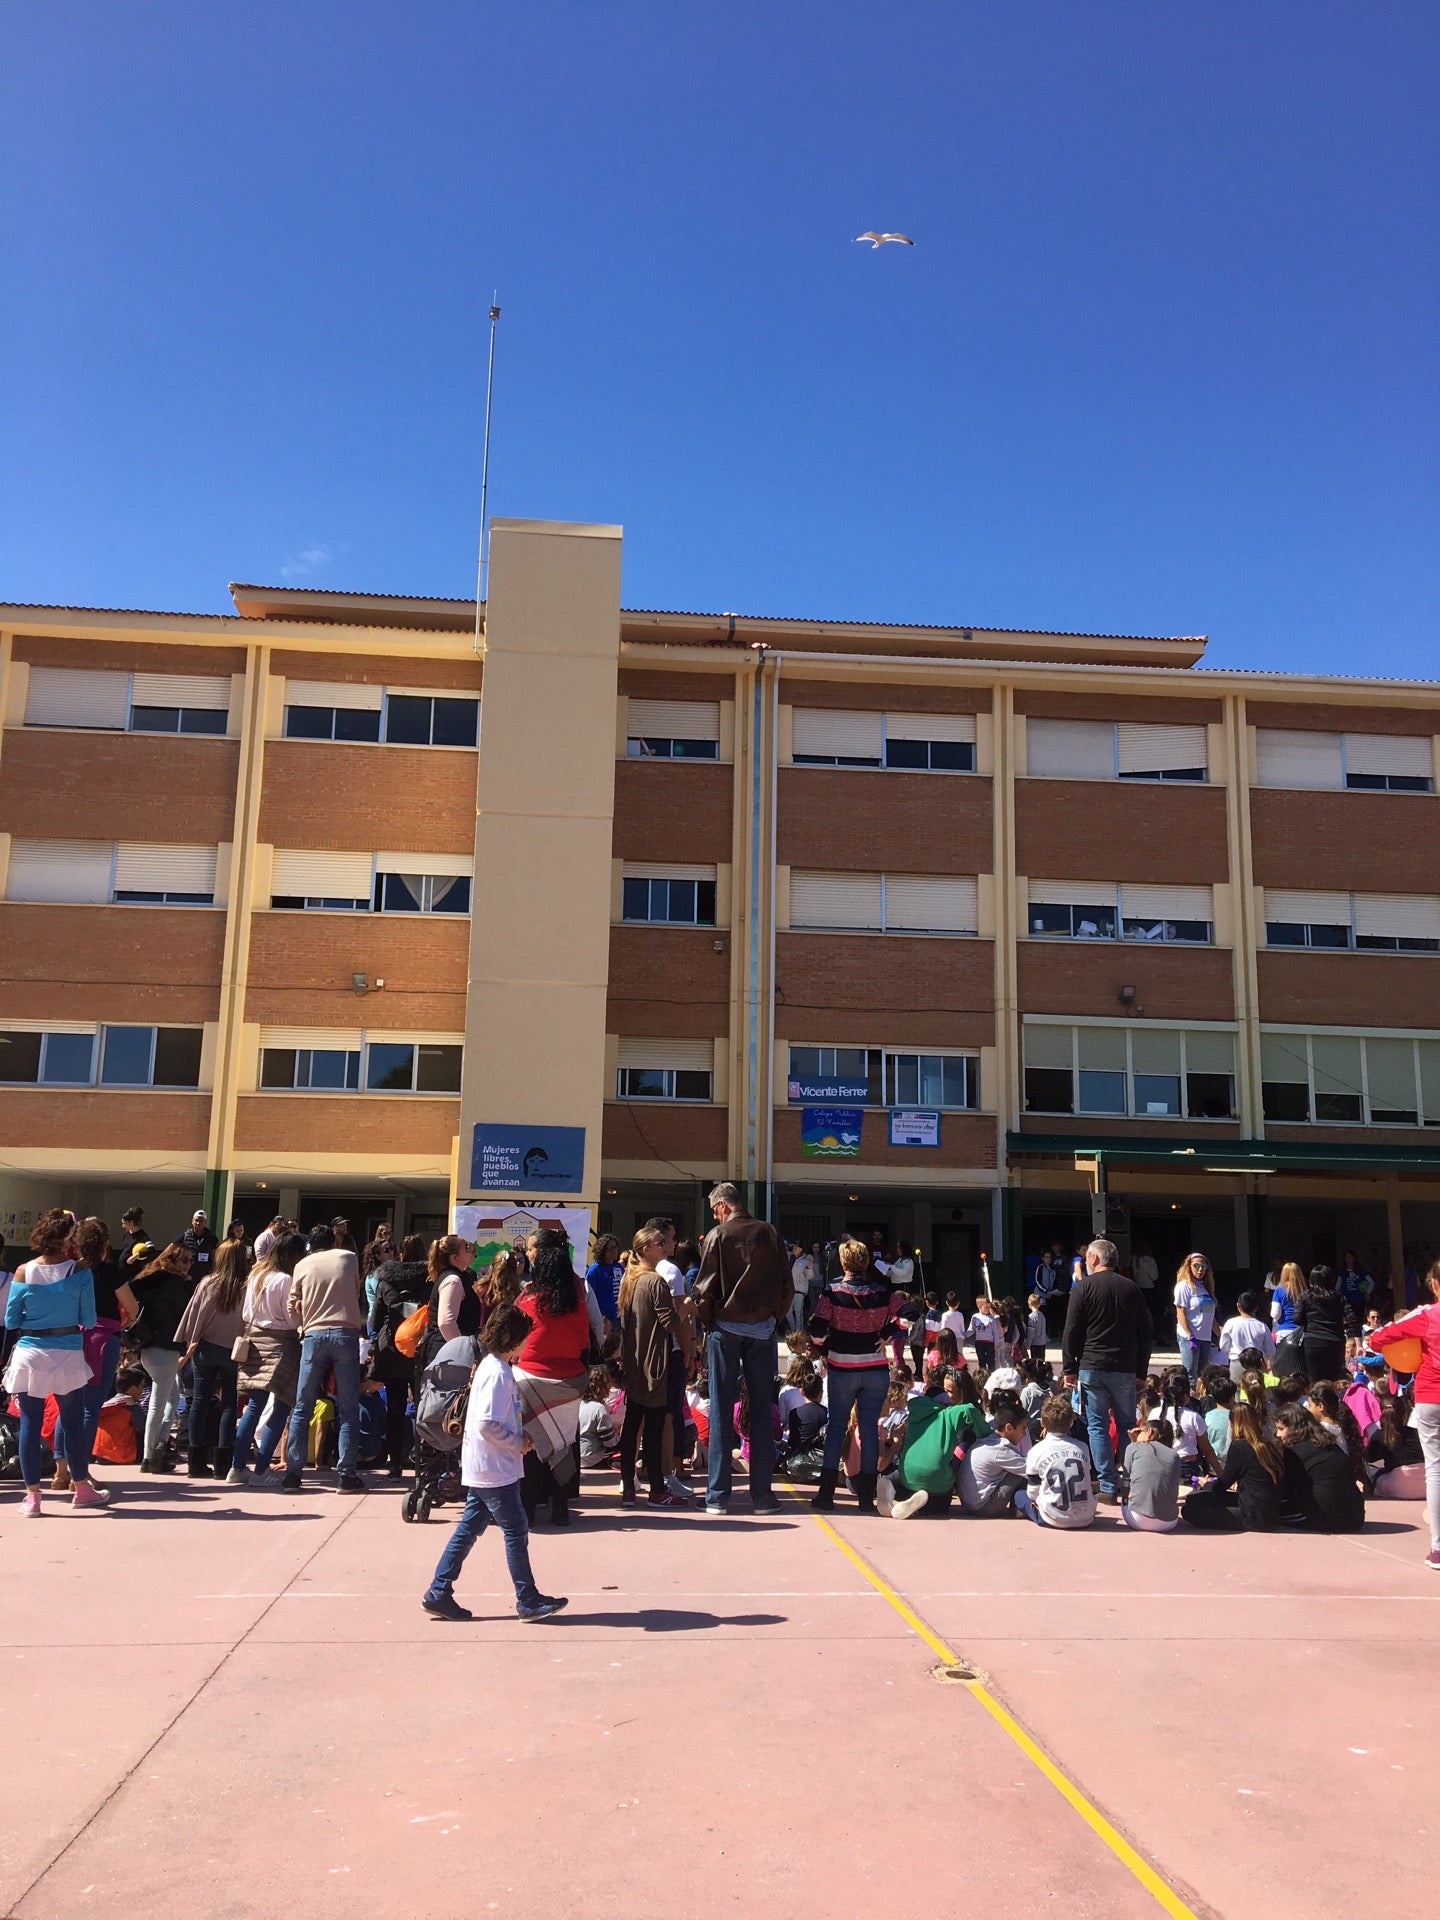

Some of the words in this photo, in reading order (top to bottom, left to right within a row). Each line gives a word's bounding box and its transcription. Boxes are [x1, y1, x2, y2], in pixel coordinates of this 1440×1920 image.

[800, 1086, 838, 1097] Vicente
[838, 1086, 868, 1097] Ferrer
[482, 1145, 520, 1156] Mujeres
[483, 1154, 512, 1164] libres,
[483, 1160, 520, 1171] pueblos
[482, 1170, 500, 1179] que
[1039, 1452, 1060, 1470] SKATE
[1061, 1450, 1070, 1458] OF
[1046, 1458, 1088, 1511] 92
